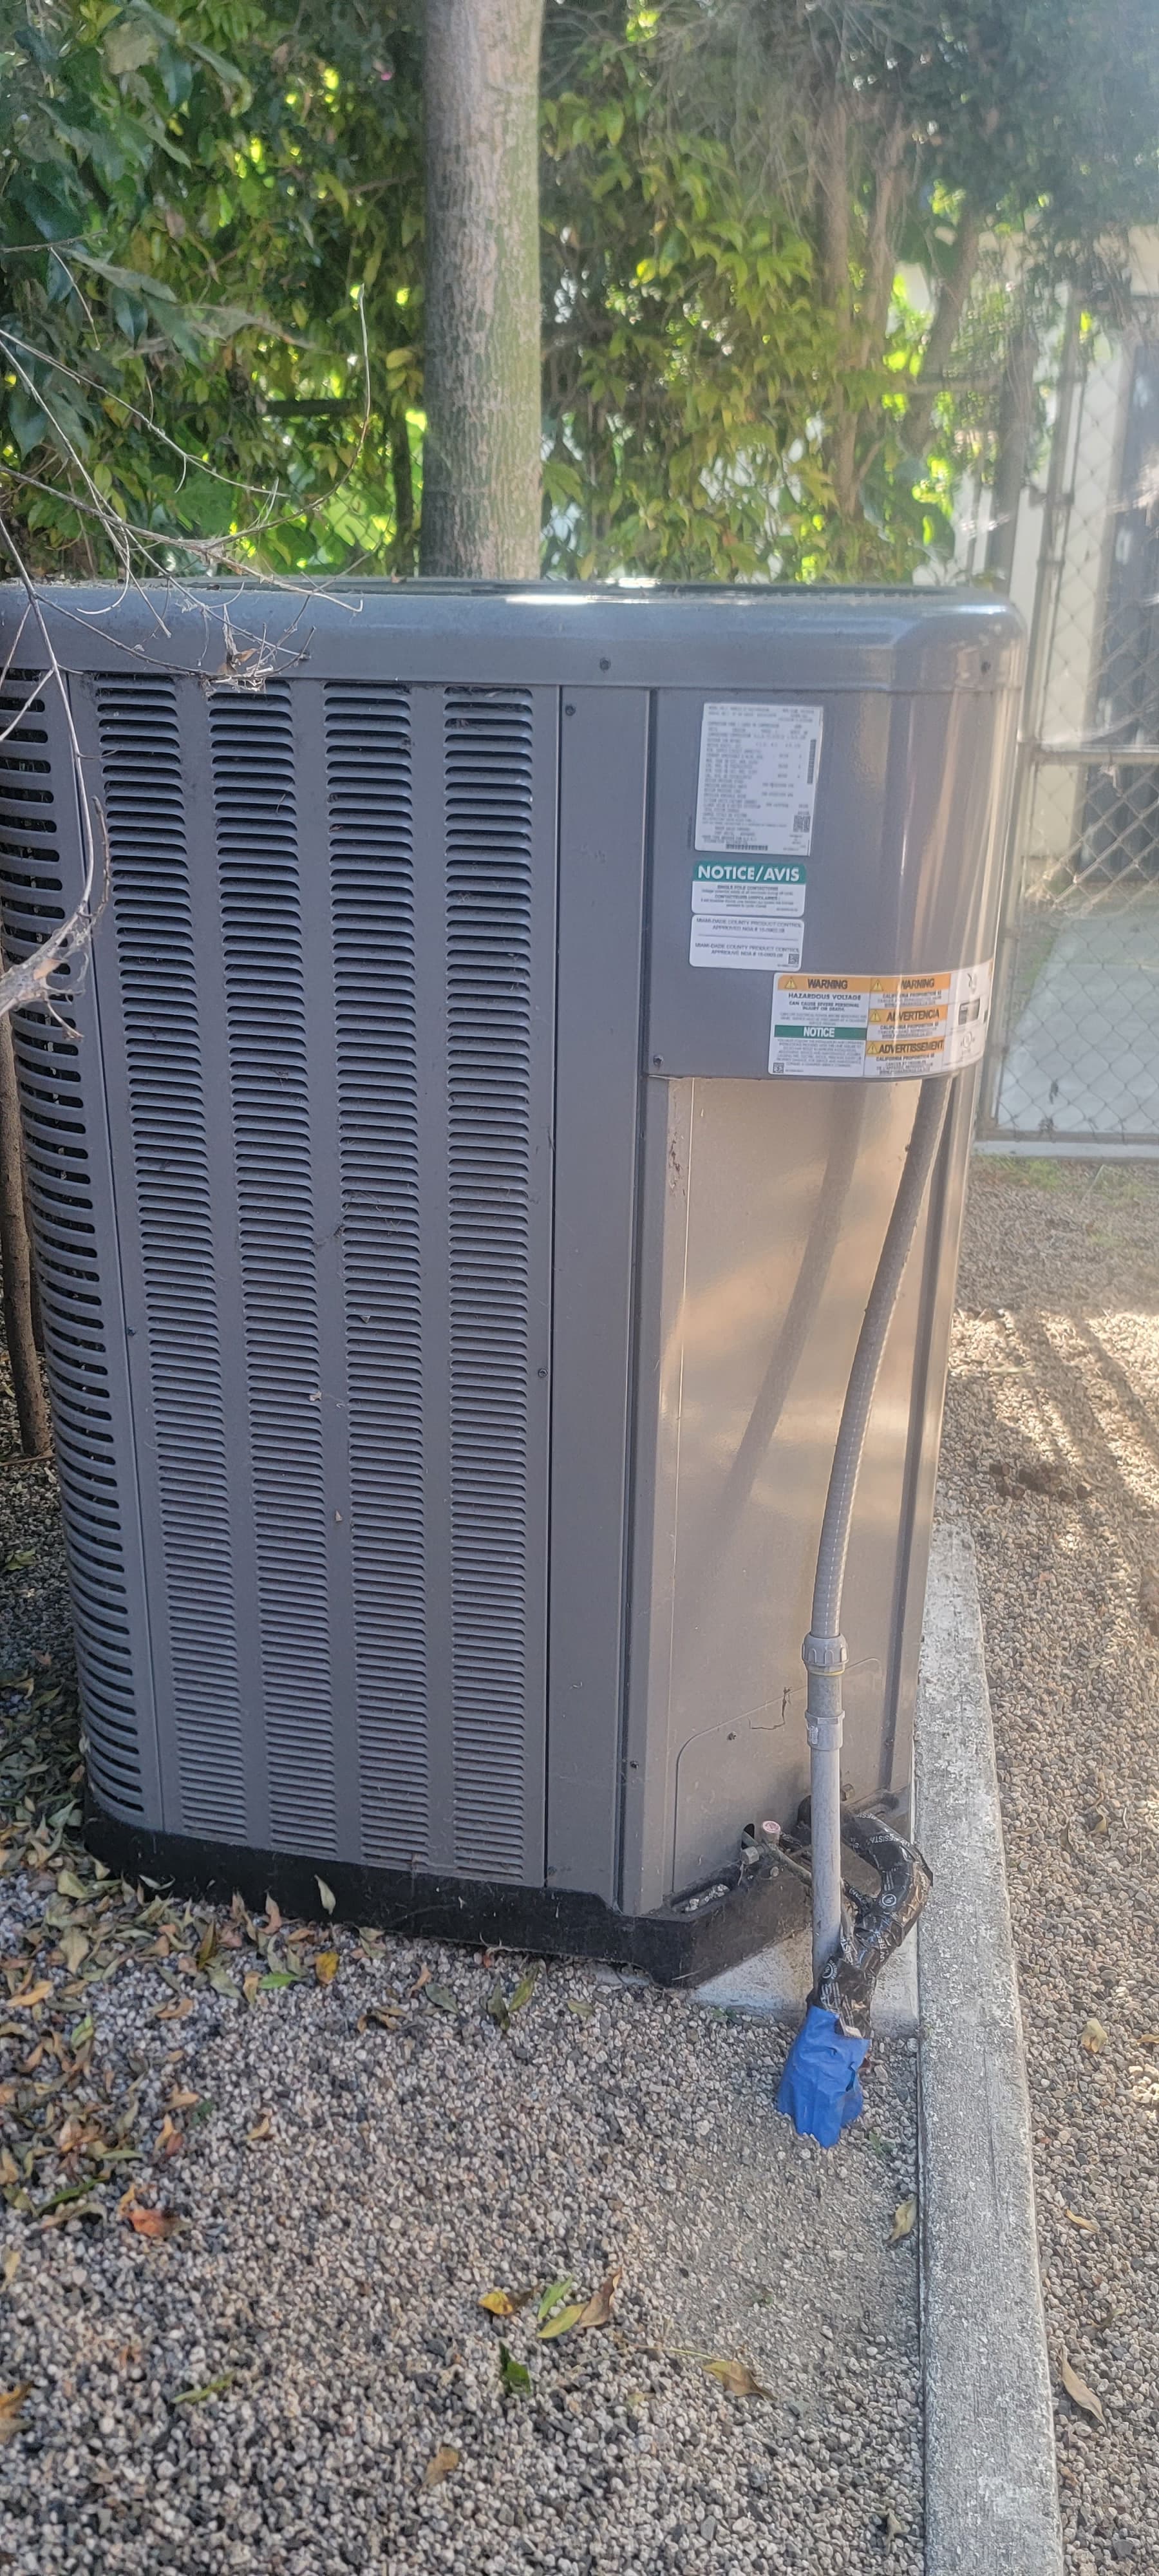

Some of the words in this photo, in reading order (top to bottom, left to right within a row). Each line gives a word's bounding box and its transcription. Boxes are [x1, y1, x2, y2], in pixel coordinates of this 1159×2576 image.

[698, 865, 800, 882] NOTICE/AVIS
[807, 979, 848, 989] WARNING
[804, 1027, 835, 1037] NOTICE
[879, 1039, 944, 1054] ADVERTISSEMENT
